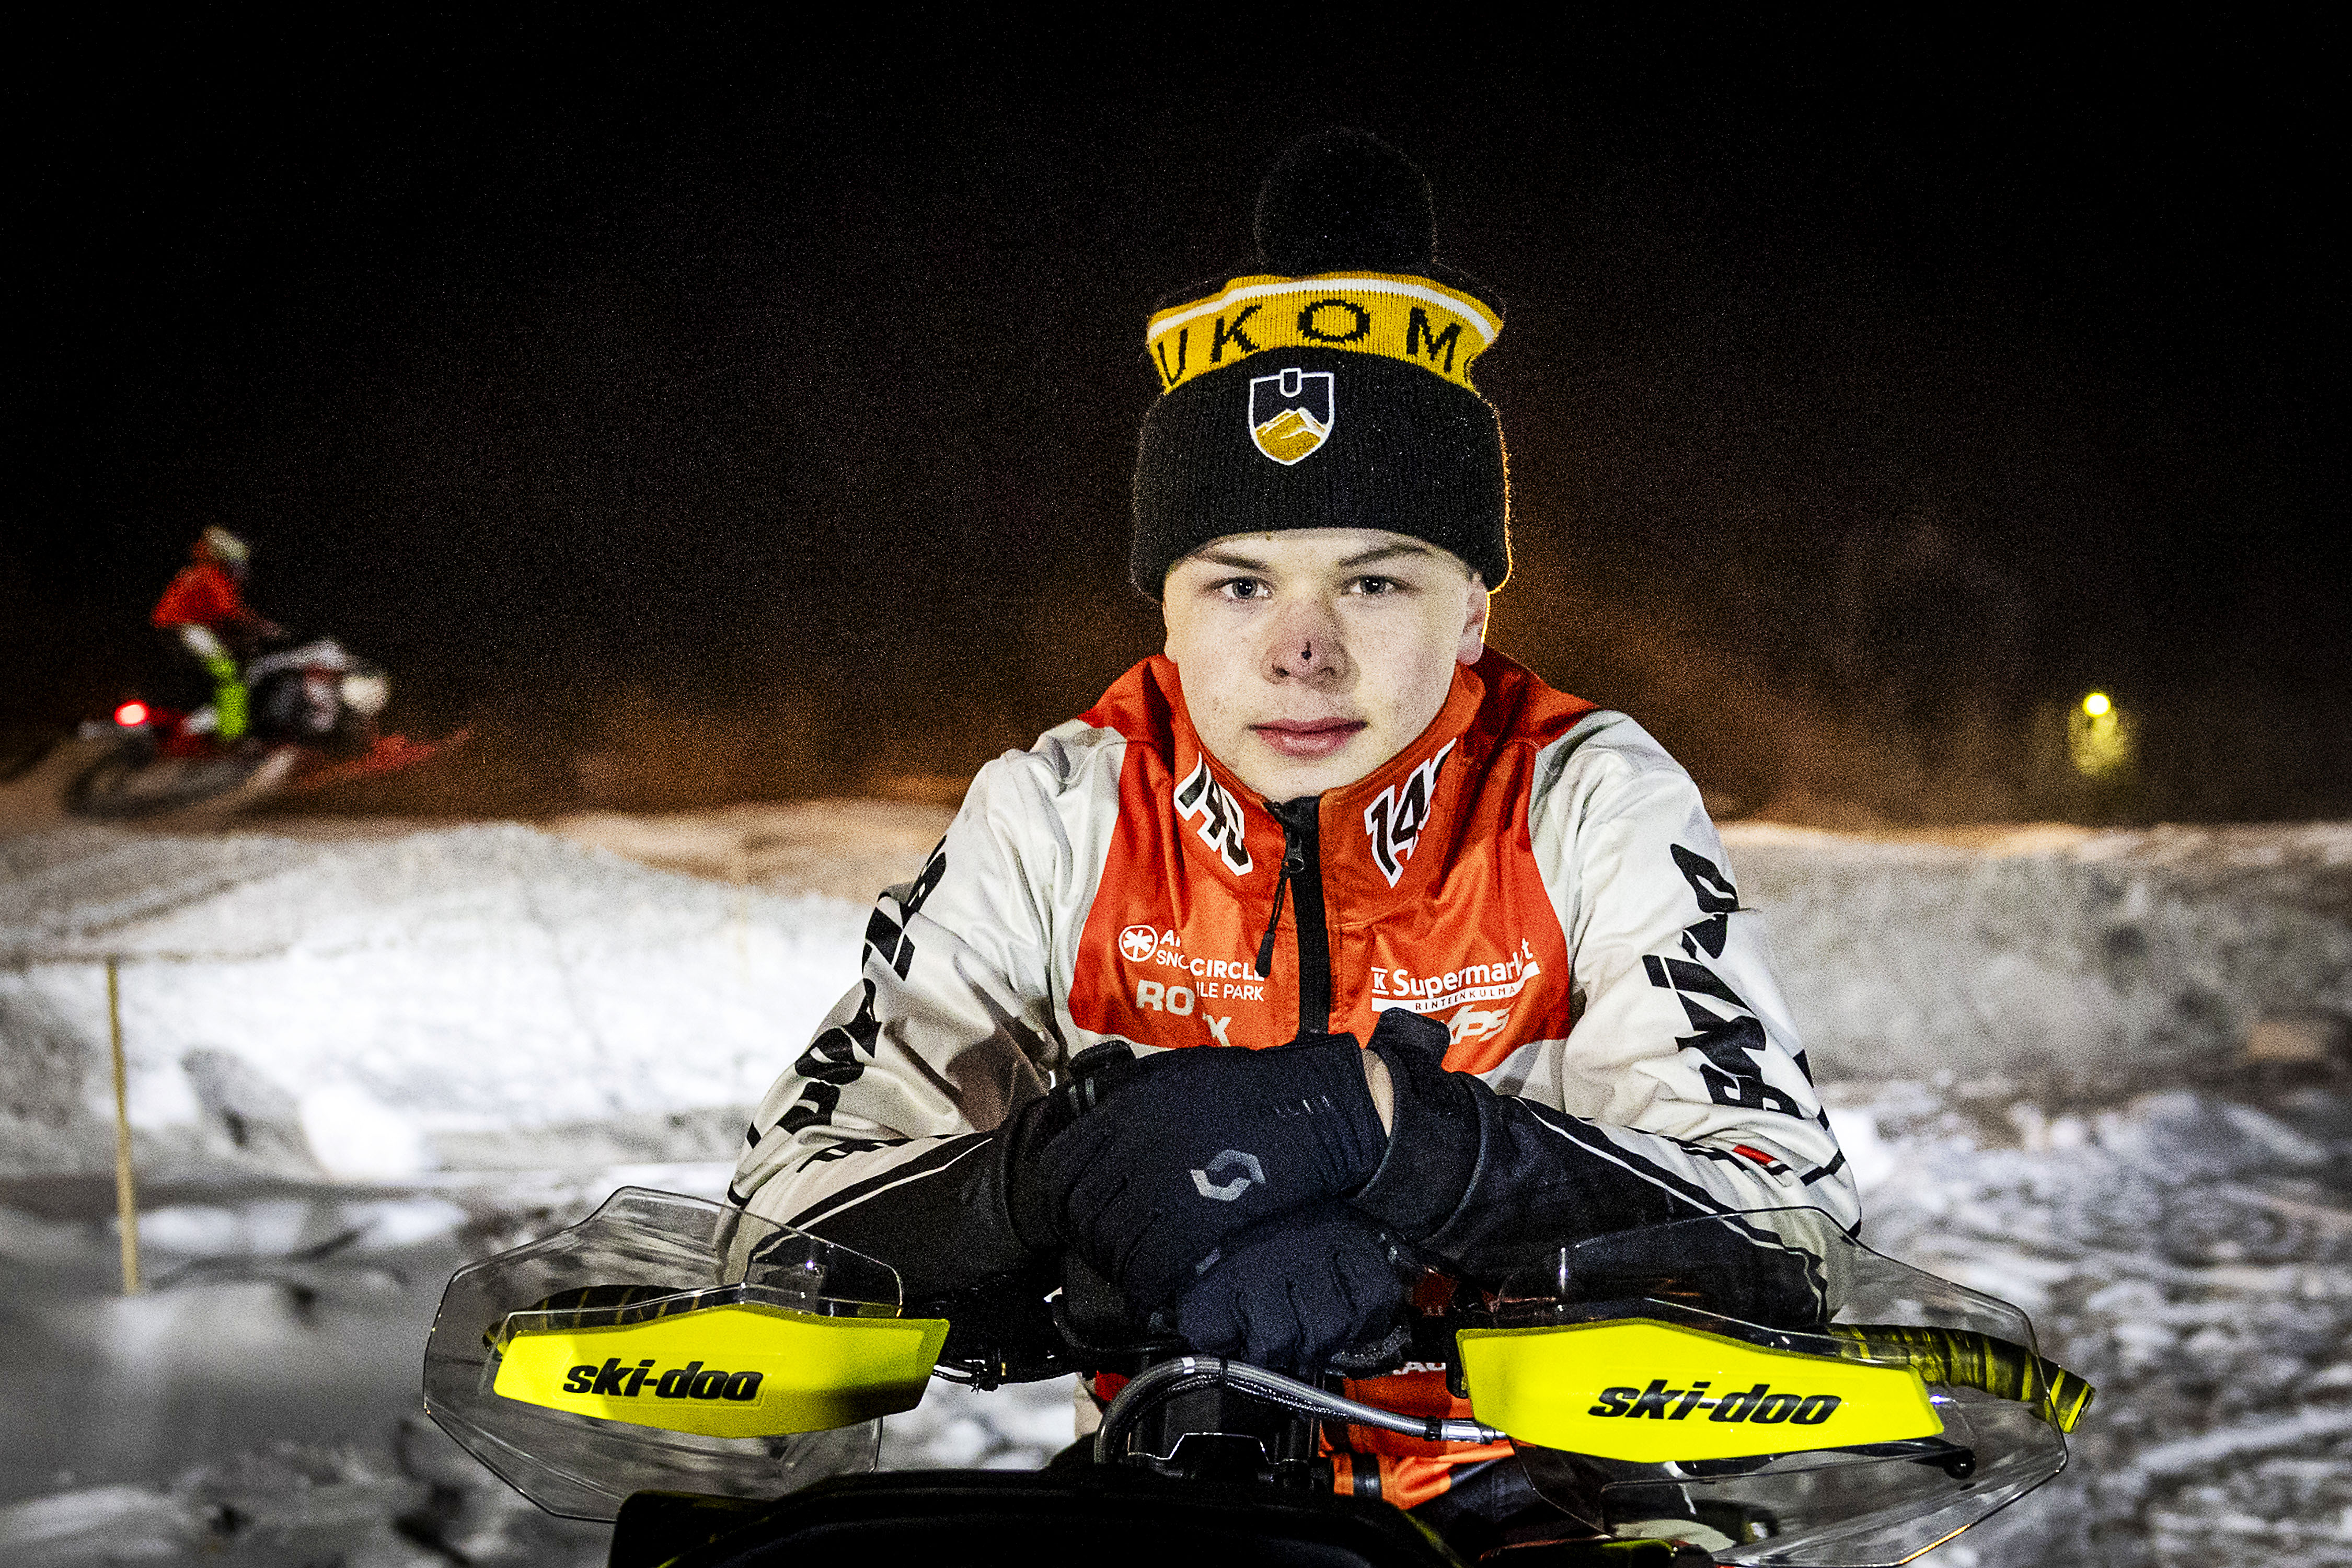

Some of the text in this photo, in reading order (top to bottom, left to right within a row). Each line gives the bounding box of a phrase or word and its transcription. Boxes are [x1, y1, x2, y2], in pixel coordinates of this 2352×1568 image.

[1157, 299, 1471, 386] UKOM
[1393, 938, 1534, 999] Supermarkt
[1223, 984, 1264, 1002] PARK
[562, 1357, 764, 1401] ski-doo
[1587, 1379, 1842, 1425] ski-doo
